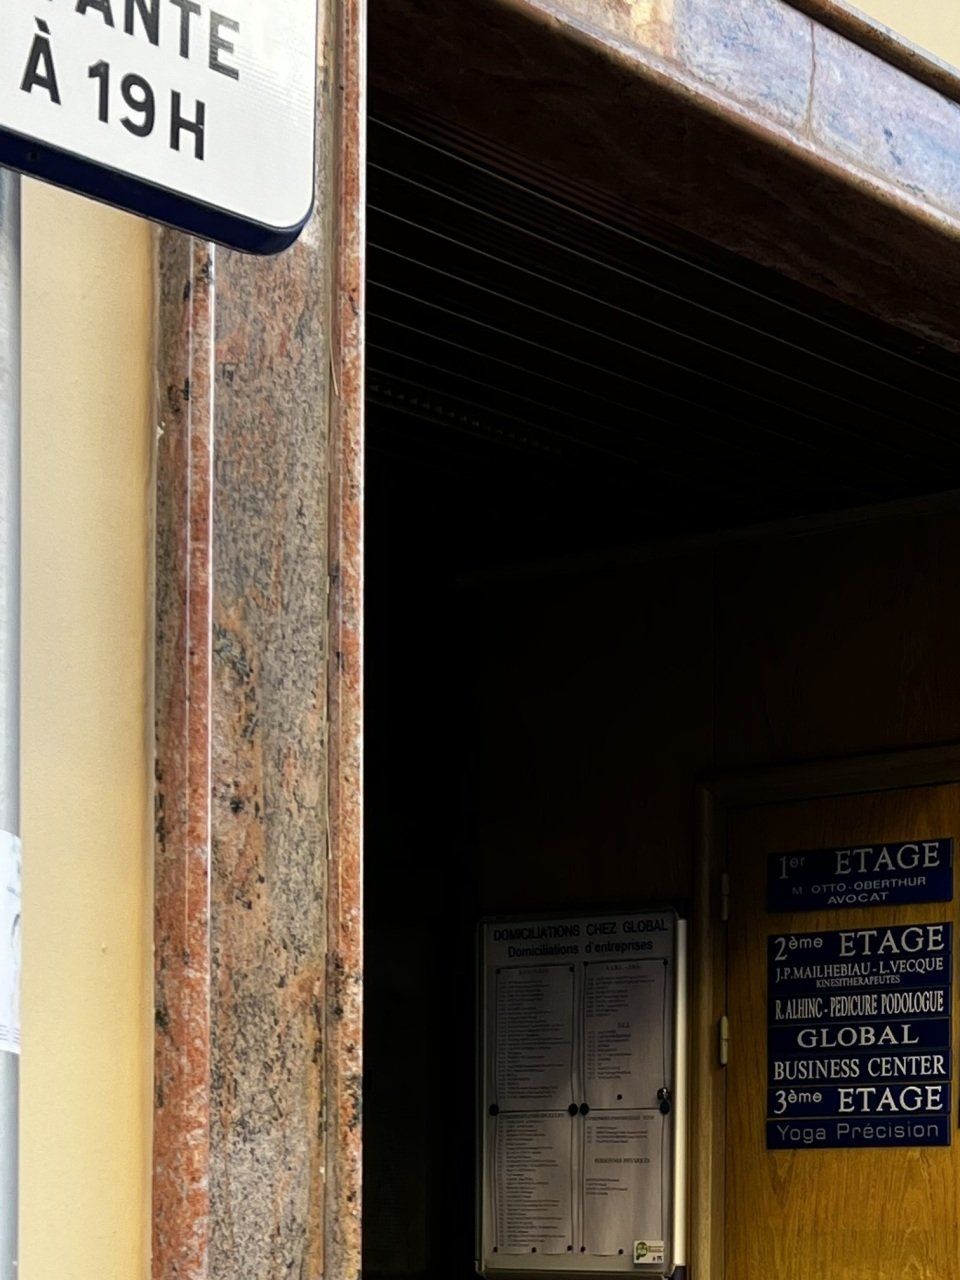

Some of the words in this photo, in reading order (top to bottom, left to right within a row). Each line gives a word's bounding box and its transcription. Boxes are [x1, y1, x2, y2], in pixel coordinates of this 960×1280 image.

[20, 16, 61, 105] À
[835, 842, 941, 875] ETAGE
[827, 891, 889, 905] AVOCAT
[494, 924, 580, 941] DOMICILIATIONS
[586, 923, 617, 936] CHEZ
[623, 919, 668, 933] GLOBAL
[839, 925, 945, 957] ETAGE
[816, 974, 900, 988] KINESITHERAPEUTES
[830, 994, 878, 1018] PEDICURE
[881, 990, 944, 1015] PODOLOGUE
[797, 1024, 919, 1048] GLOBAL
[774, 1058, 860, 1081] BUSINESS
[867, 1055, 946, 1077] CENTER
[774, 1089, 823, 1114] 3ème
[838, 1086, 943, 1112] ETAGE
[777, 1124, 826, 1144] Yoga
[837, 1121, 939, 1139] Précision
